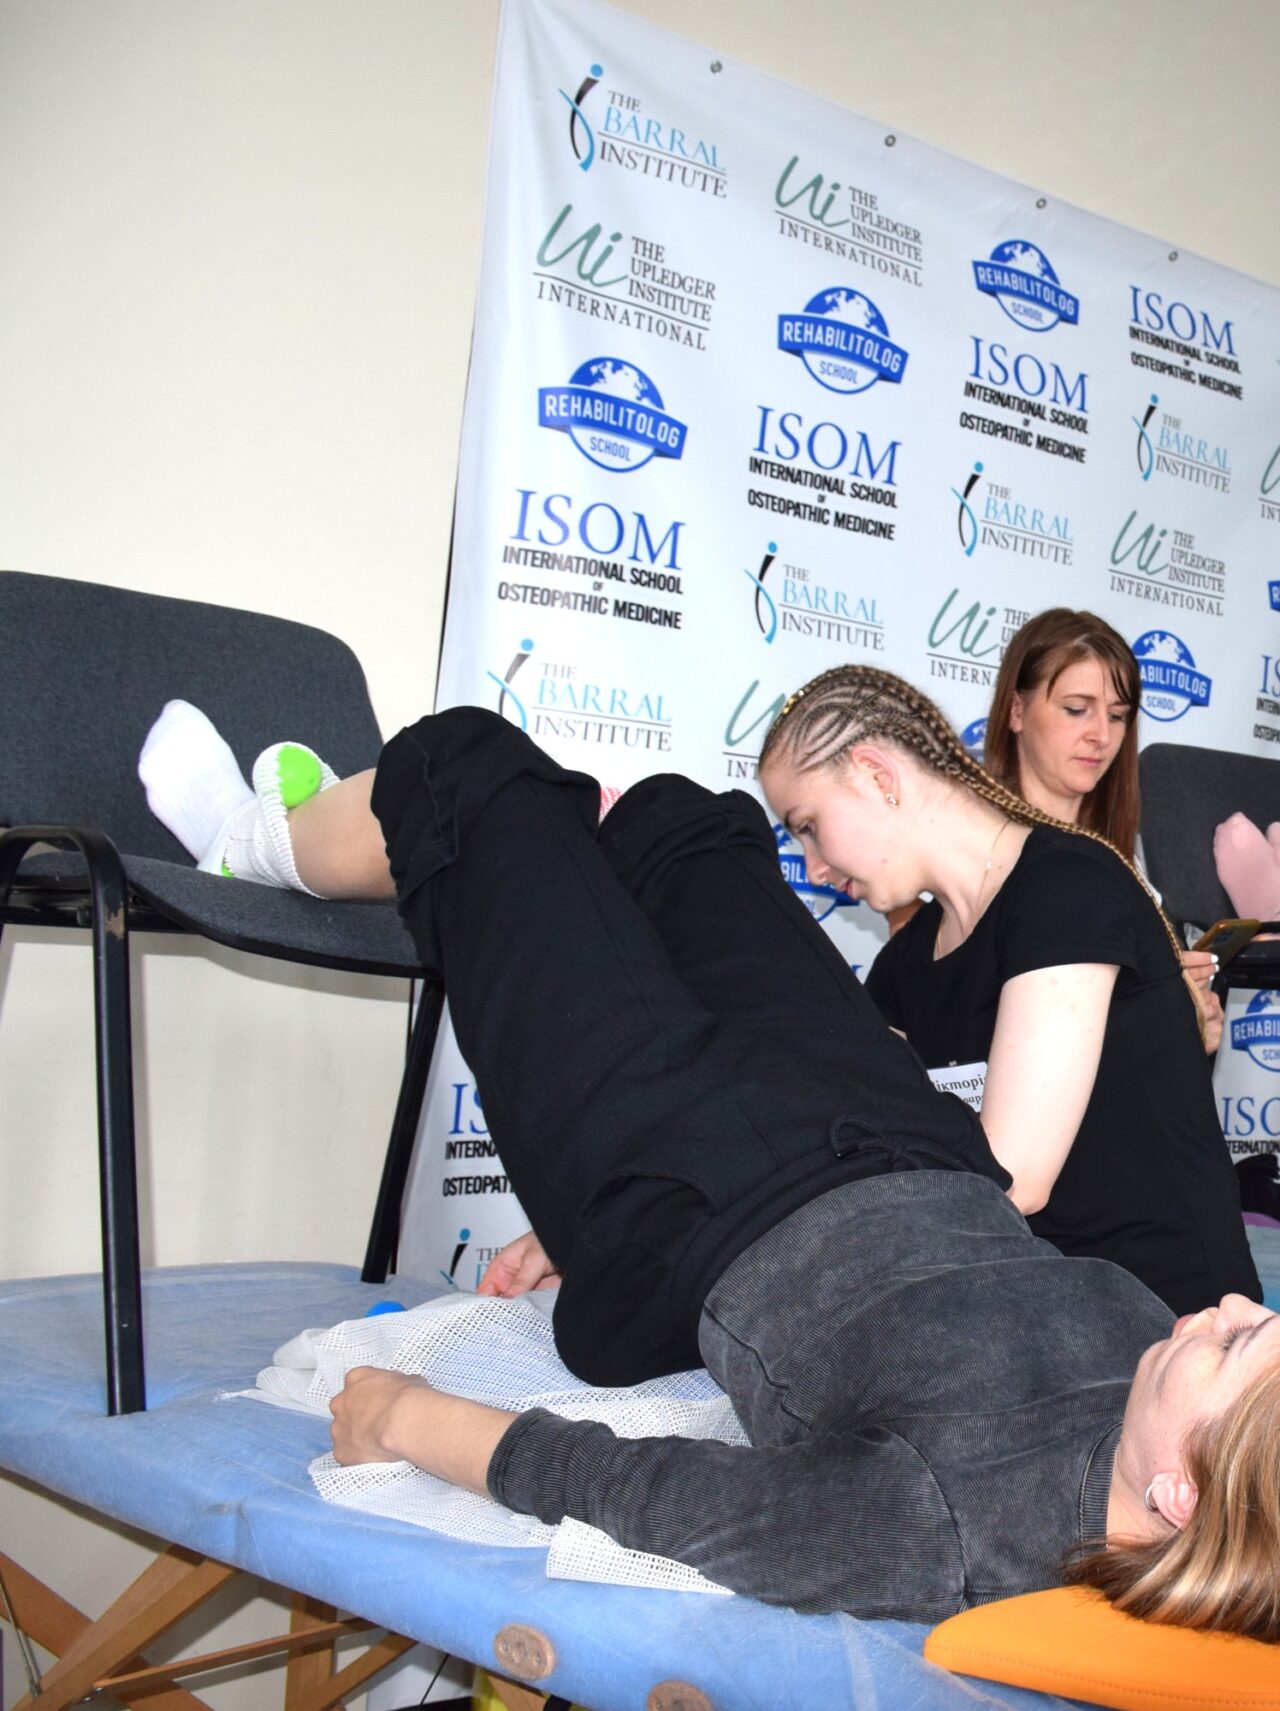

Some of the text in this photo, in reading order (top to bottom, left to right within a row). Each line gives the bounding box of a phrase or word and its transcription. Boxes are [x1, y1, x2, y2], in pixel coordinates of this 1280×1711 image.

[609, 90, 641, 112] THE
[603, 106, 726, 170] BARRAL
[600, 141, 727, 198] INSTITUTE
[849, 187, 878, 210] THE
[851, 204, 922, 245] UPLEDGER
[852, 222, 922, 262] INSTITUTE
[632, 237, 665, 262] THE
[780, 219, 922, 287] INTERNATIONAL
[629, 279, 711, 323] INSTITUTE
[631, 258, 716, 301] UPLEDGER
[978, 266, 1075, 316] REHABILITOLOG
[537, 282, 706, 351] INTERNATIONAL
[1012, 302, 1043, 324] SCHOOL
[1130, 285, 1237, 357] ISOM
[783, 320, 902, 373] REHABILITOLOG
[1129, 325, 1242, 374] INTERNATIONAL SCHOOL
[820, 360, 858, 385] SCHOOL
[970, 336, 1089, 413] ISOM
[1131, 351, 1243, 400] OSTEOPATHIC MEDICINE
[545, 394, 680, 449] REHABILITOLOG
[964, 381, 1089, 434] INTERNATIONAL SCHOOL
[1162, 413, 1182, 430] THE
[590, 436, 631, 461] SCHOOL
[754, 405, 902, 486] ISOM
[960, 412, 1086, 463] OSTEOPATHIC MEDICINE
[1159, 427, 1231, 470] BARRAL
[749, 456, 897, 509] INTERNATIONAL SCHOOL
[987, 483, 1011, 500] THE
[1156, 455, 1231, 494] INSTITUTE
[510, 488, 687, 570] ISOM
[748, 489, 895, 541] OSTEOPATHIC MEDICINE
[984, 497, 1073, 541] BARRAL
[981, 527, 1072, 566] INSTITUTE
[1173, 530, 1194, 549] THE
[503, 546, 683, 595] INTERNATIONAL SCHOOL
[783, 564, 809, 582] THE
[1168, 565, 1225, 593] INSTITUTE
[1171, 547, 1226, 576] UPLEDGER
[498, 581, 682, 629] OSTEOPATHIC MEDICINE
[782, 579, 884, 625] BARRAL
[1110, 575, 1224, 616] INTERNATIONAL
[781, 611, 884, 652] INSTITUTE
[541, 662, 576, 679] THE
[1140, 664, 1208, 698] ABILITOLOG
[539, 678, 671, 722] BARRAL
[1146, 695, 1176, 712] SCHOOL
[534, 714, 671, 752] INSTITUTE
[936, 1074, 986, 1092] ікторі
[443, 1176, 514, 1197] OSTEOPAT
